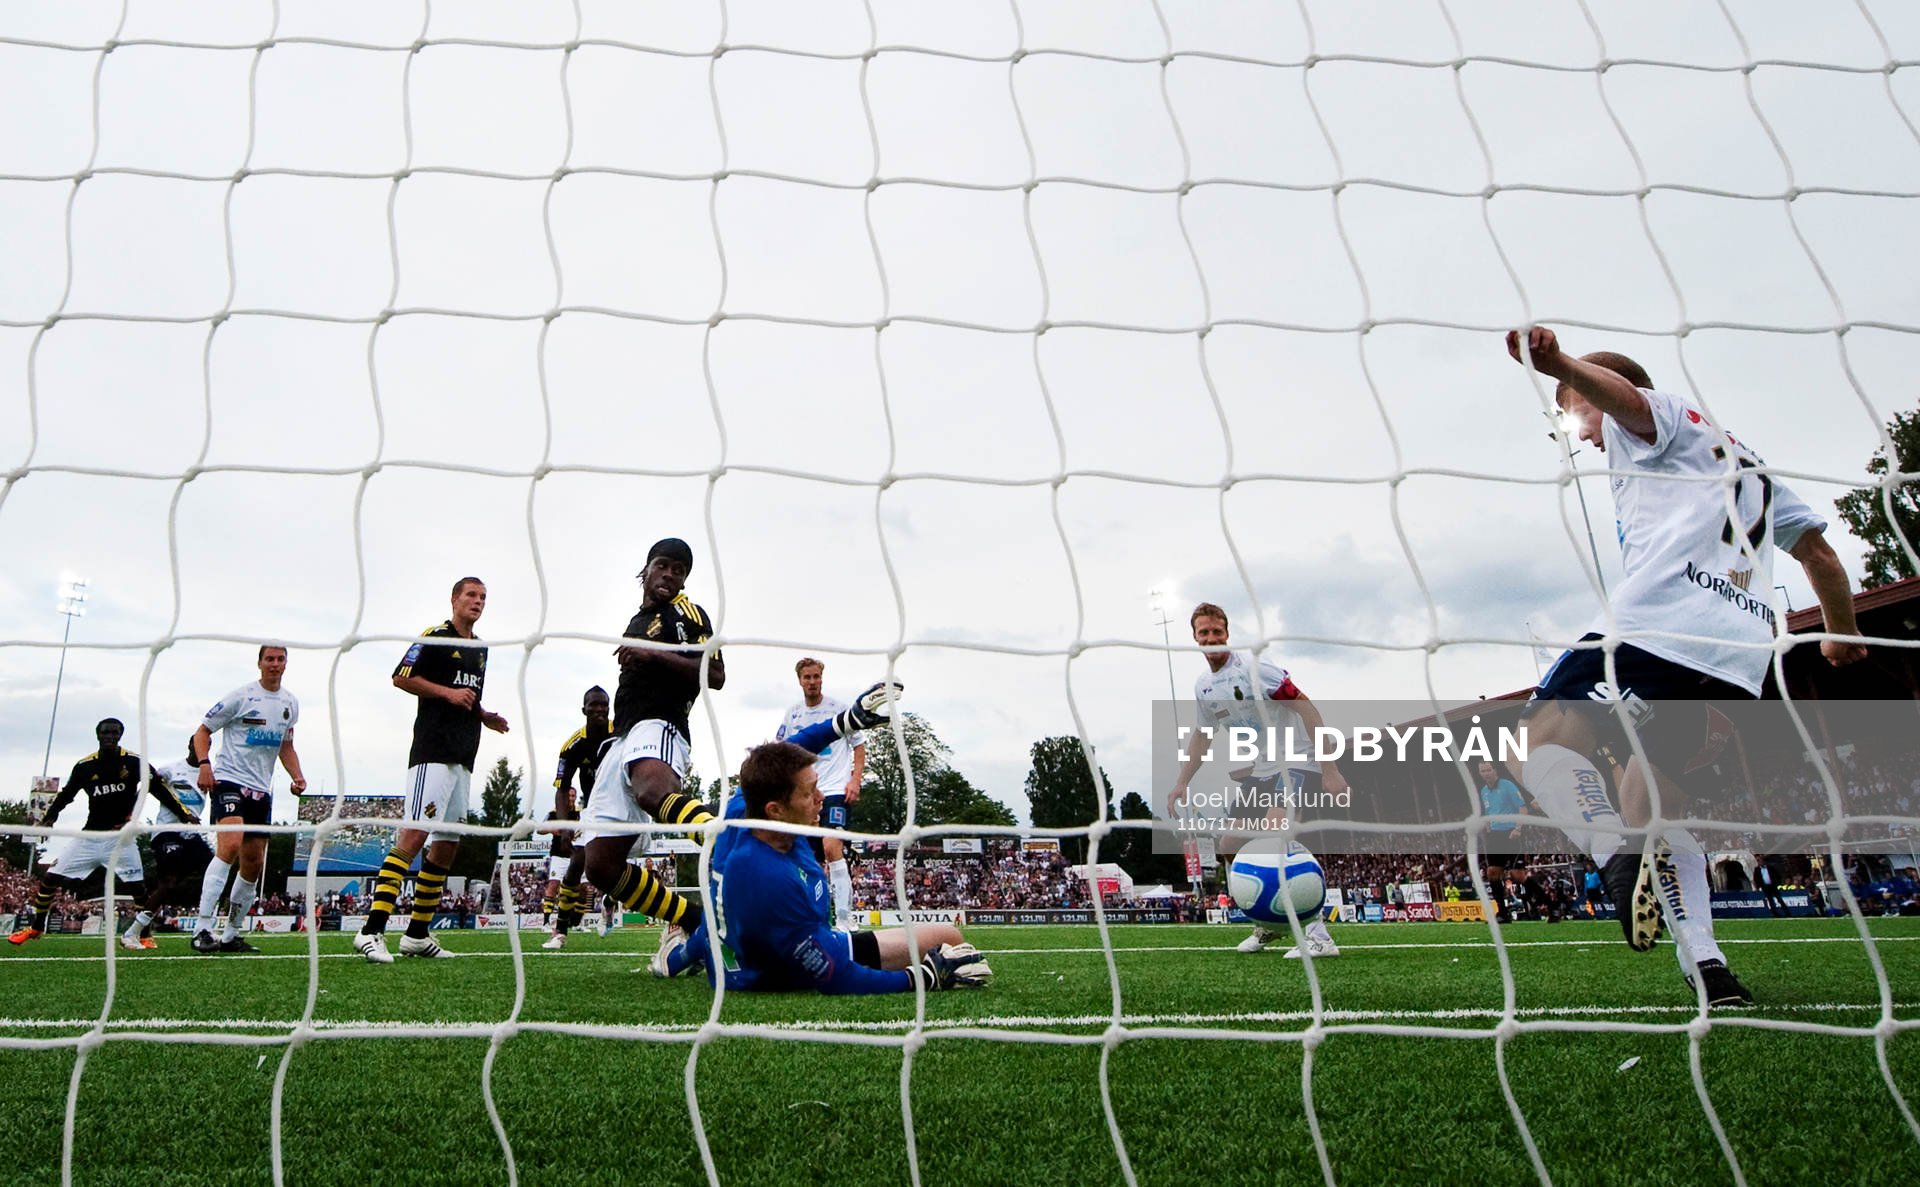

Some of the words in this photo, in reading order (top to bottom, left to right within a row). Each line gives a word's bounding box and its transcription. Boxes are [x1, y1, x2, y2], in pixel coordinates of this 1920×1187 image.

[224, 803, 236, 813] 19
[525, 841, 553, 852] Dagbla
[1408, 905, 1434, 919] Scandic
